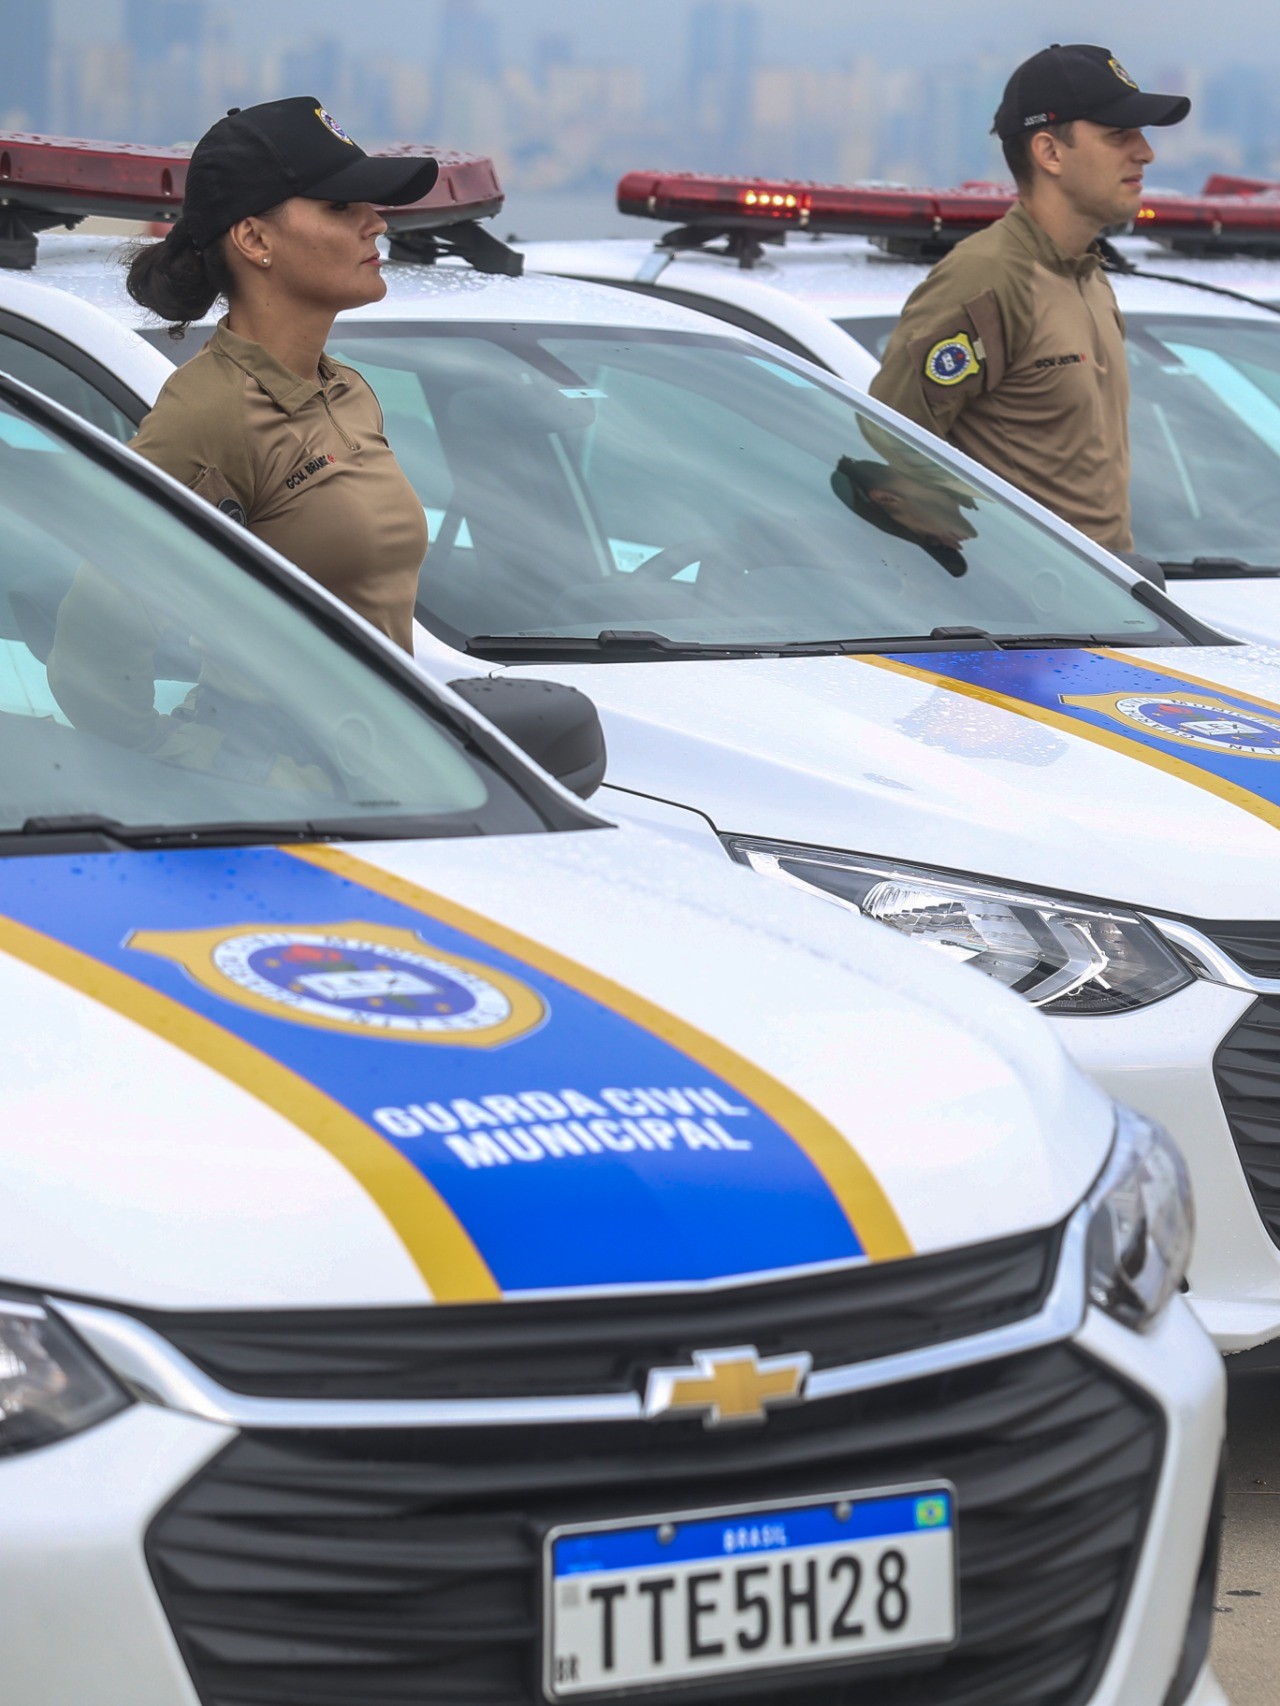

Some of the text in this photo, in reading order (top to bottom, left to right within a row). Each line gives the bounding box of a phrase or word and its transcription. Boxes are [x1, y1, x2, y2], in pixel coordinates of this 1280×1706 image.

[373, 1087, 750, 1138] GUARDA CIVIL
[443, 1117, 753, 1169] MUNICIPAL
[723, 1522, 788, 1554] BRASIL
[588, 1548, 910, 1673] TTE5H28
[555, 1654, 580, 1683] BR
